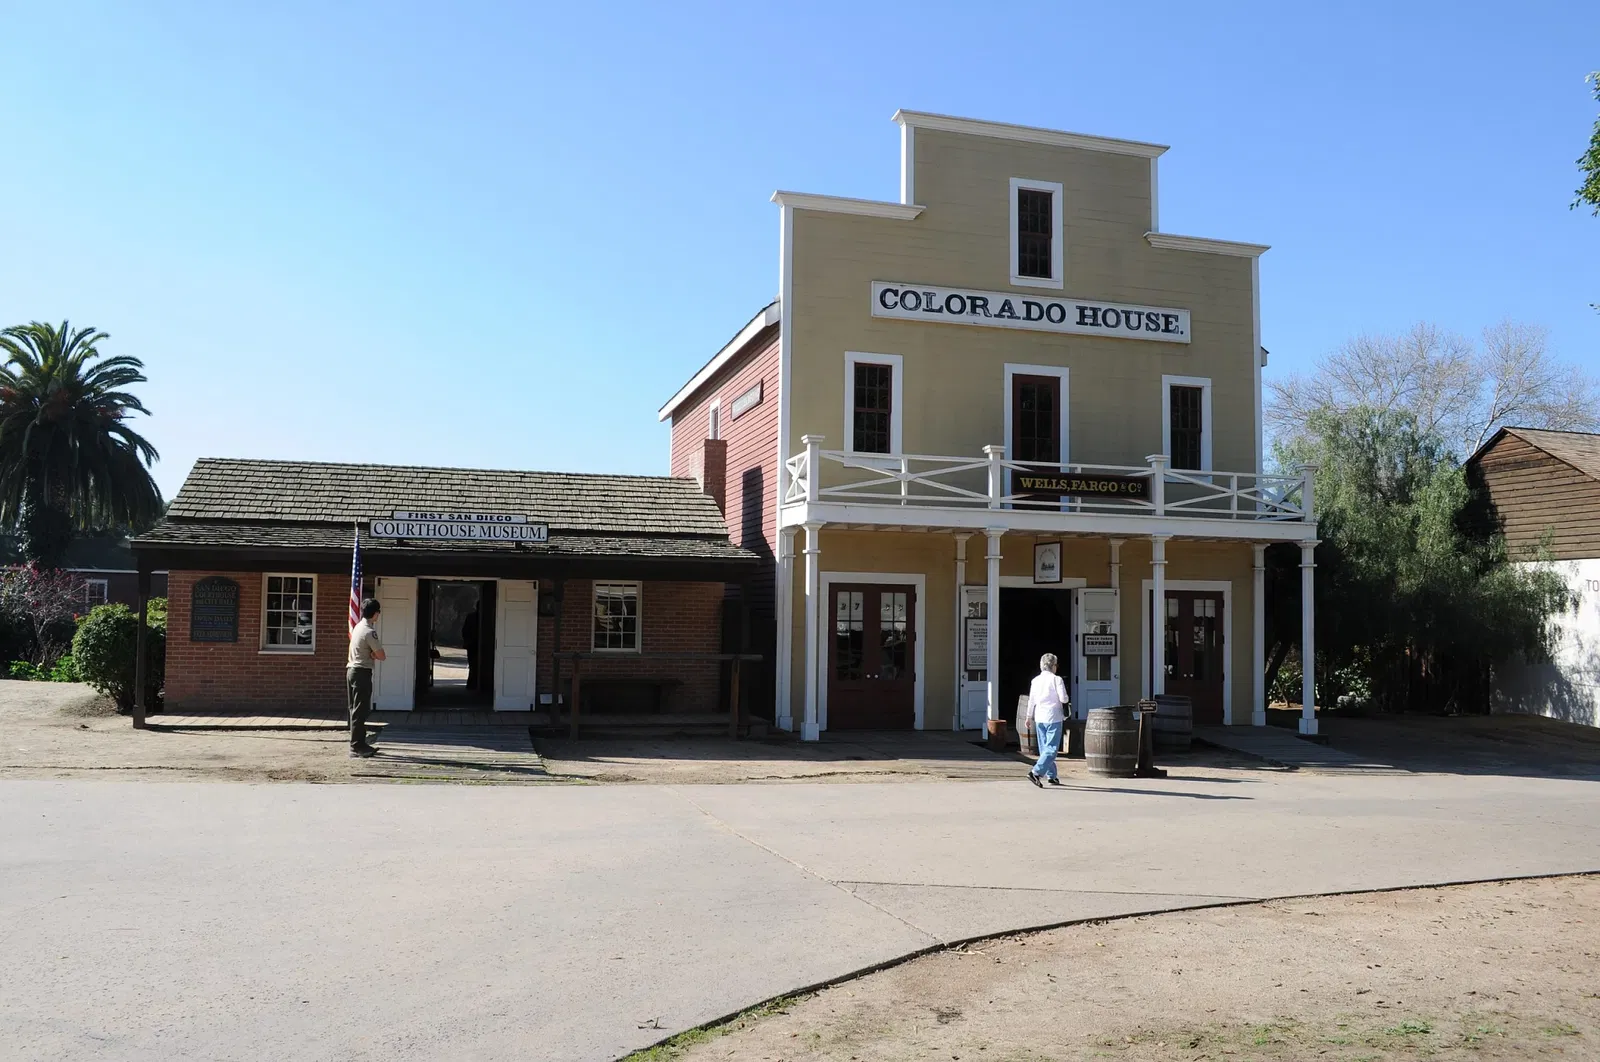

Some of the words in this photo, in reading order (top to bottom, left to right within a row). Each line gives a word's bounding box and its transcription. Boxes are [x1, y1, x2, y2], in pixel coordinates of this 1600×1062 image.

[879, 288, 1066, 324] COLORADO
[1075, 305, 1184, 336] HOUSE.
[408, 512, 444, 520] FIRST
[448, 513, 472, 521] SAN
[476, 514, 512, 522] DIEGO
[373, 522, 476, 538] COURTHOUSE
[479, 525, 545, 540] MUSEUM.
